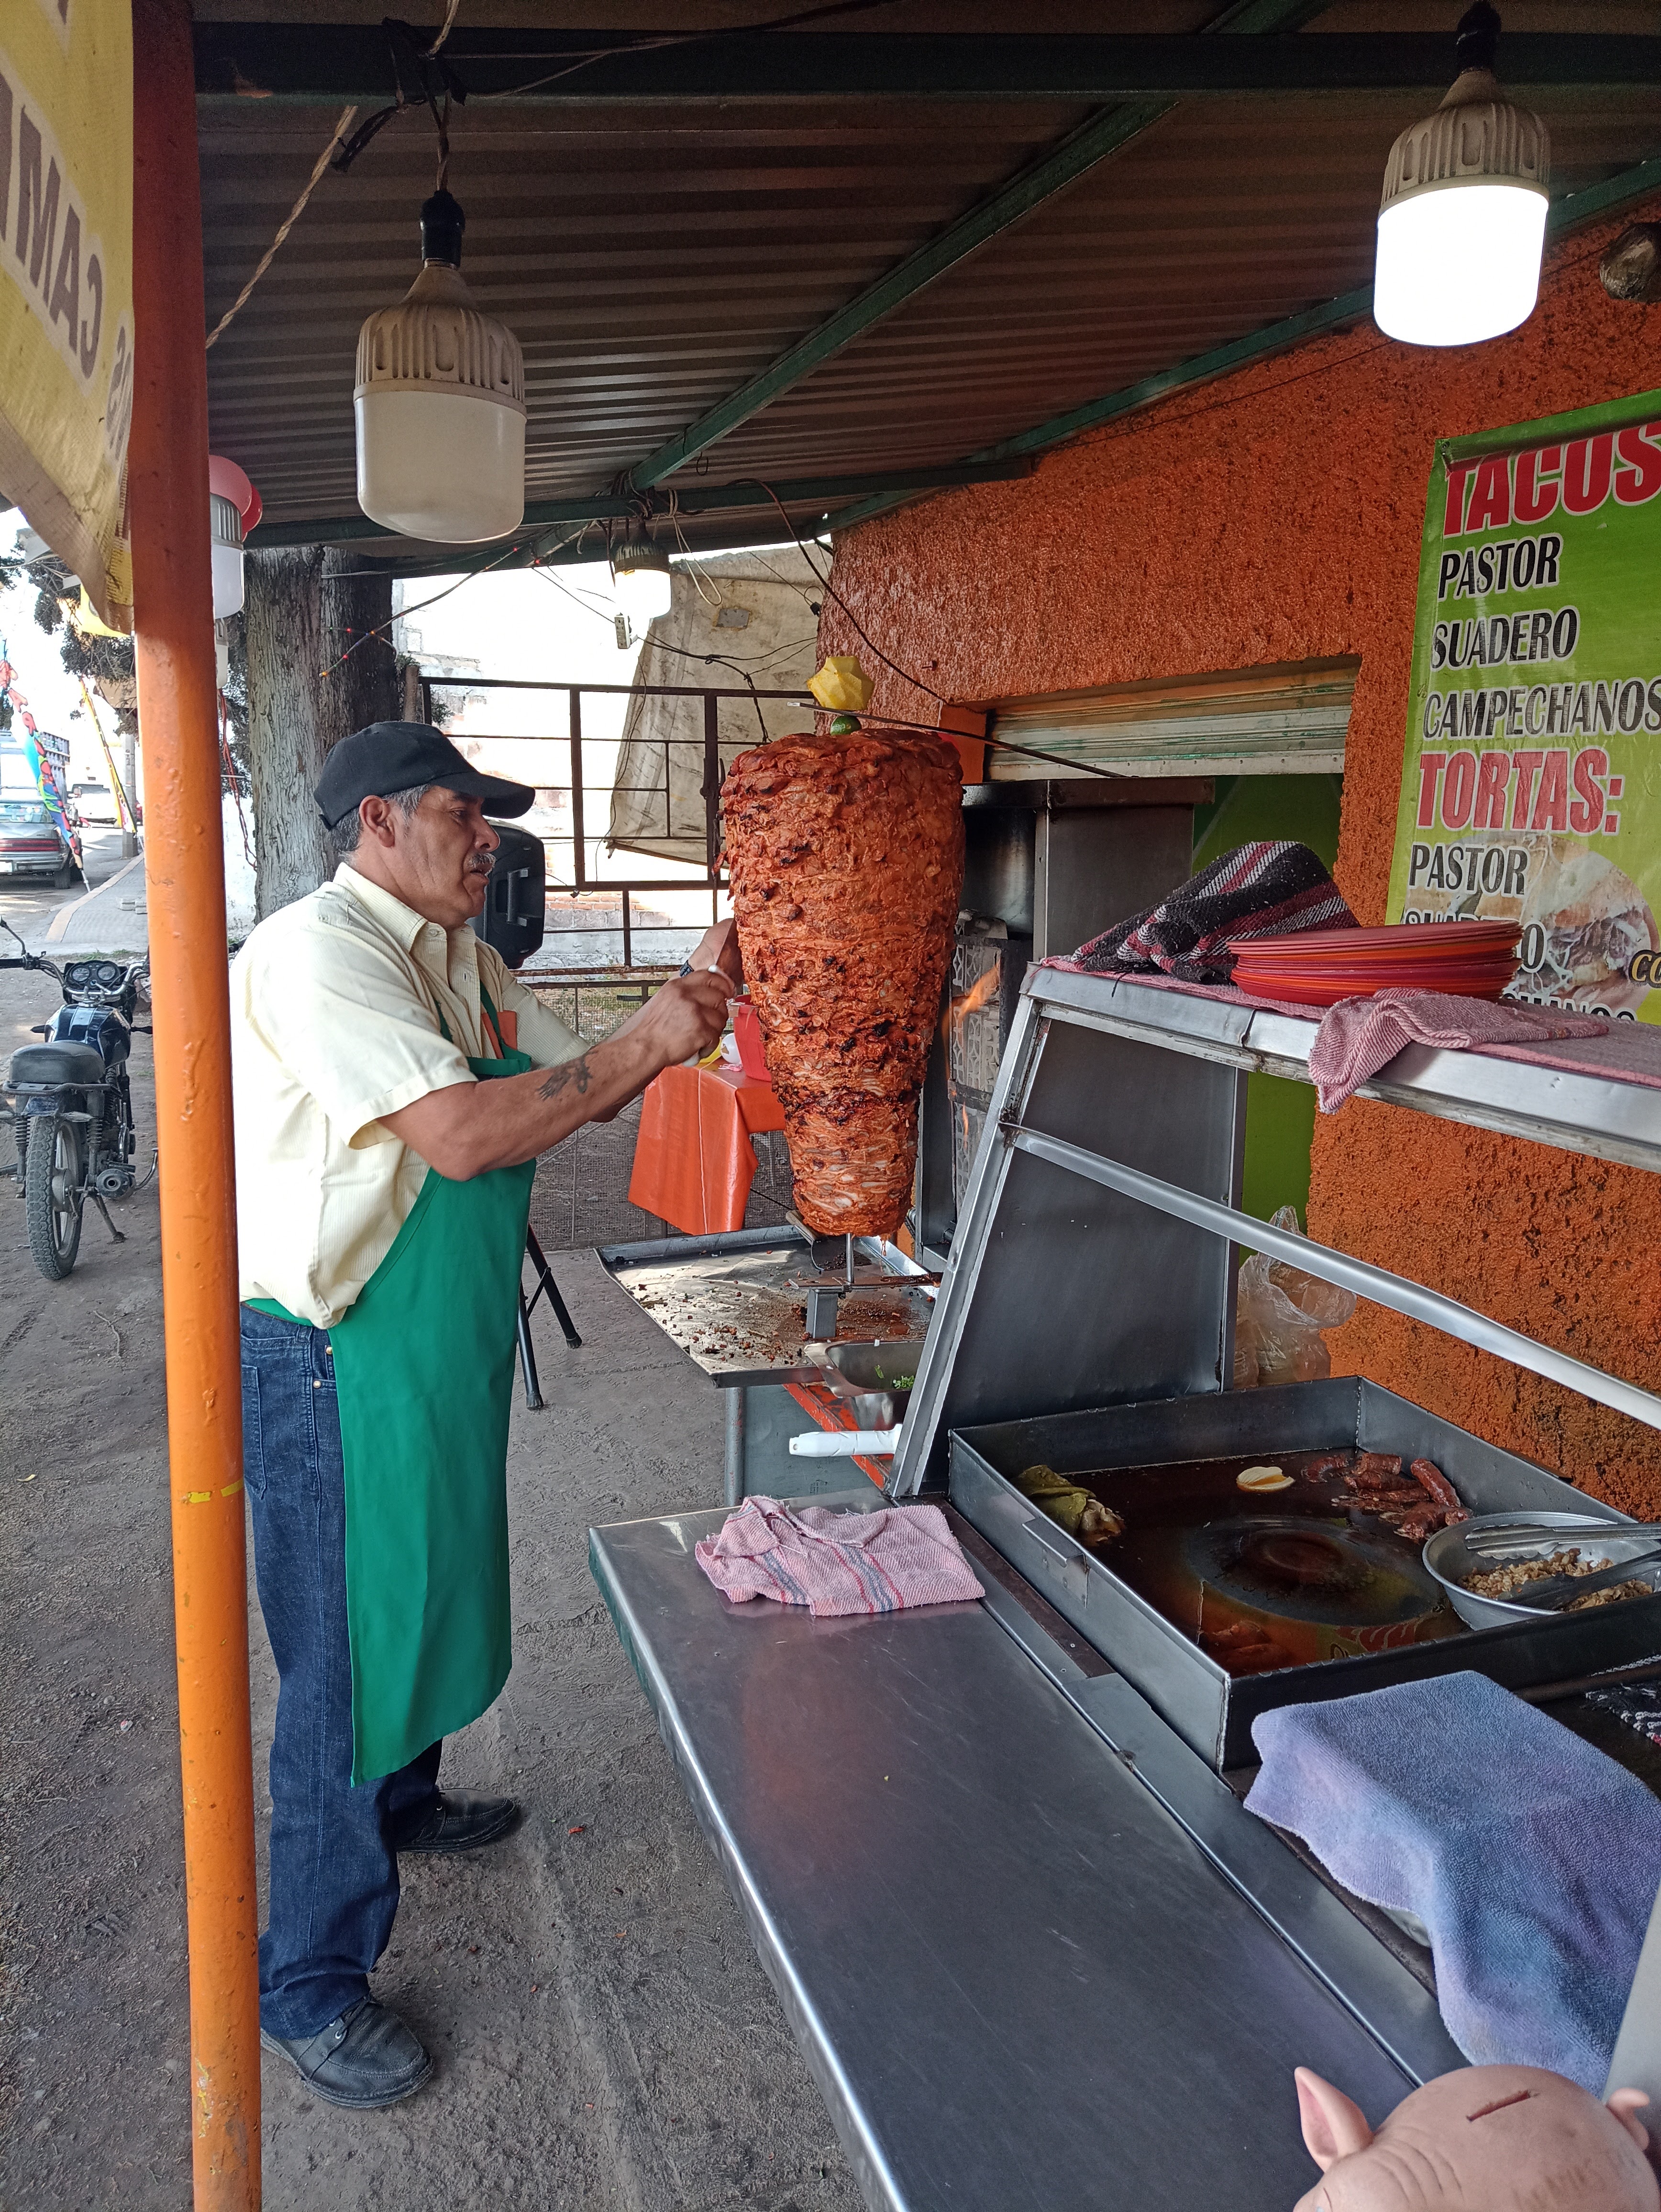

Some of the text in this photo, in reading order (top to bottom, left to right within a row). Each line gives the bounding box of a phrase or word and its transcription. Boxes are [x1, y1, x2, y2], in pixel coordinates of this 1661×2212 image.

[1442, 420, 1661, 538] TACOS
[1438, 536, 1561, 599] PASTOR
[1431, 608, 1578, 669] SUADERO
[1423, 679, 1661, 738] CAMPECHANOS
[1417, 749, 1623, 833] TORTAS:
[1409, 844, 1528, 895] PASTOR
